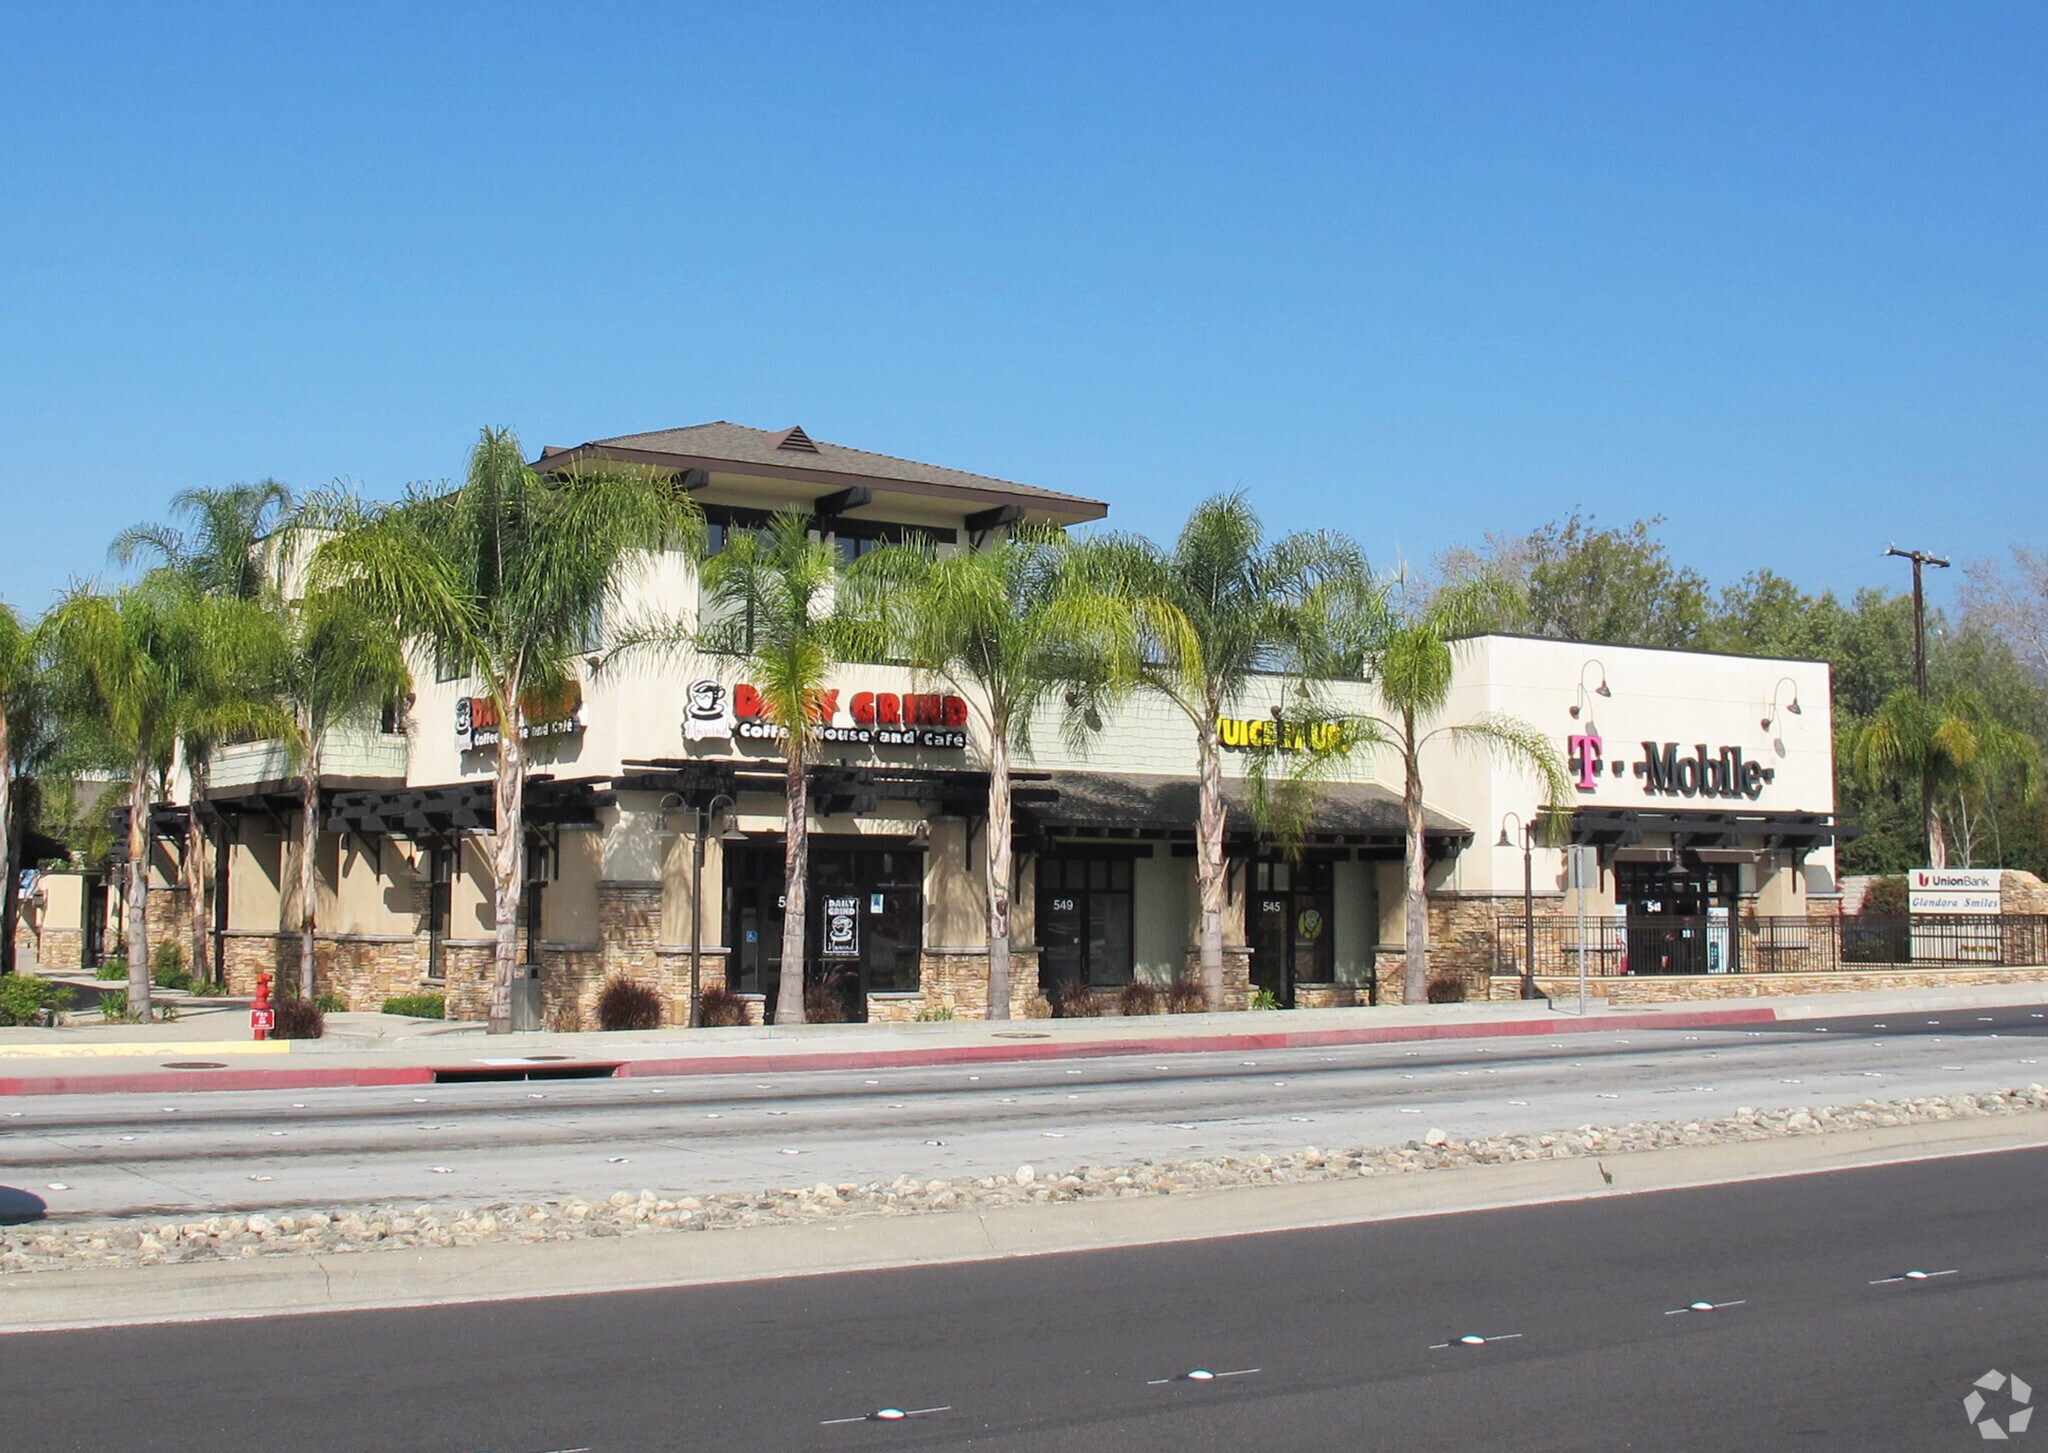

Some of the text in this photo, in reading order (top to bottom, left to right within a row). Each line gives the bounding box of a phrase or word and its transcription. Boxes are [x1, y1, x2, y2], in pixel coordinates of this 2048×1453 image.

[850, 691, 968, 727] GRIND
[1216, 717, 1278, 747] UICE
[879, 731, 915, 744] and
[923, 733, 965, 748] Café
[1932, 875, 1990, 887] UnionBank
[828, 899, 856, 908] DAILY
[1053, 899, 1074, 911] 549
[1262, 901, 1281, 912] 545
[1911, 897, 1999, 908] Glendora Smiles
[827, 907, 856, 916] GRIND
